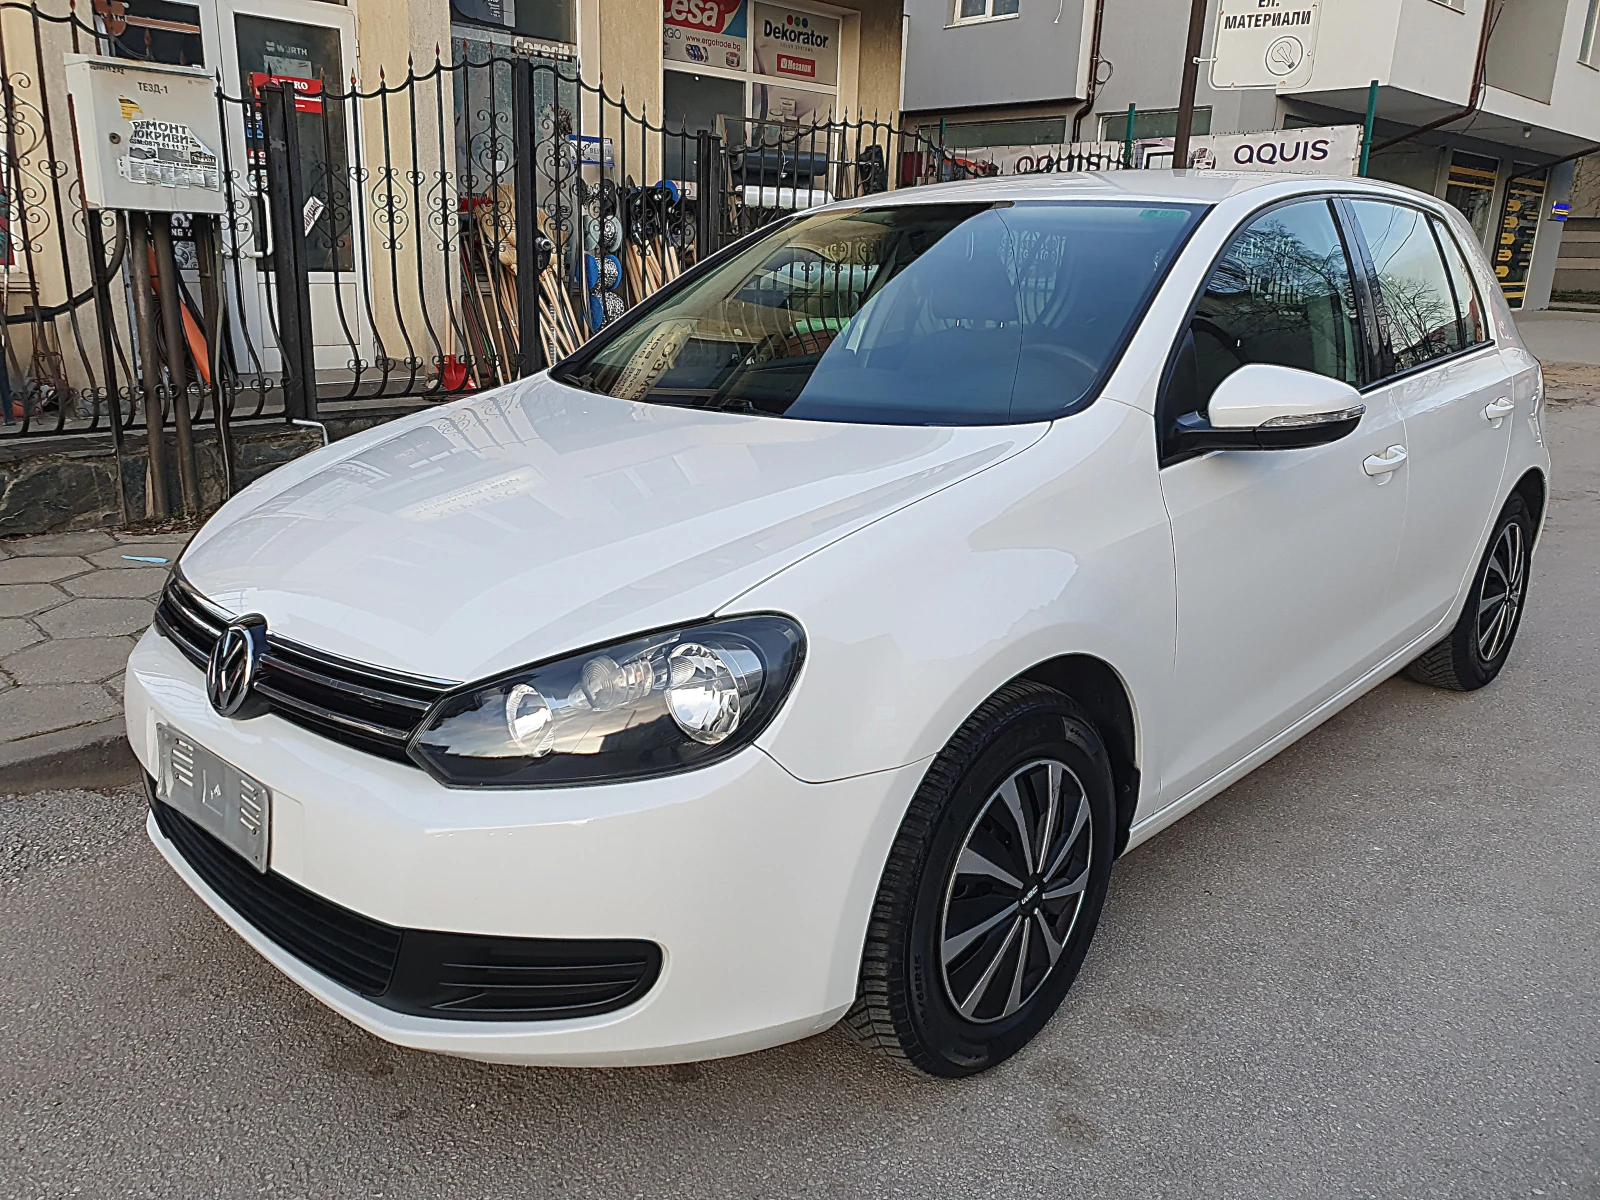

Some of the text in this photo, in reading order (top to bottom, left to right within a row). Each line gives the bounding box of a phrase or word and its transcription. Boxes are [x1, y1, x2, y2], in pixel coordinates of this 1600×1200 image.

[664, 0, 719, 27] esa
[1224, 10, 1311, 29] МАТЕРИАЛИ
[764, 19, 829, 48] Dekorator
[686, 35, 741, 51] www.ergotrade.bg
[137, 82, 168, 94] ТЕЗД-1
[132, 121, 188, 135] РЕМОНТ
